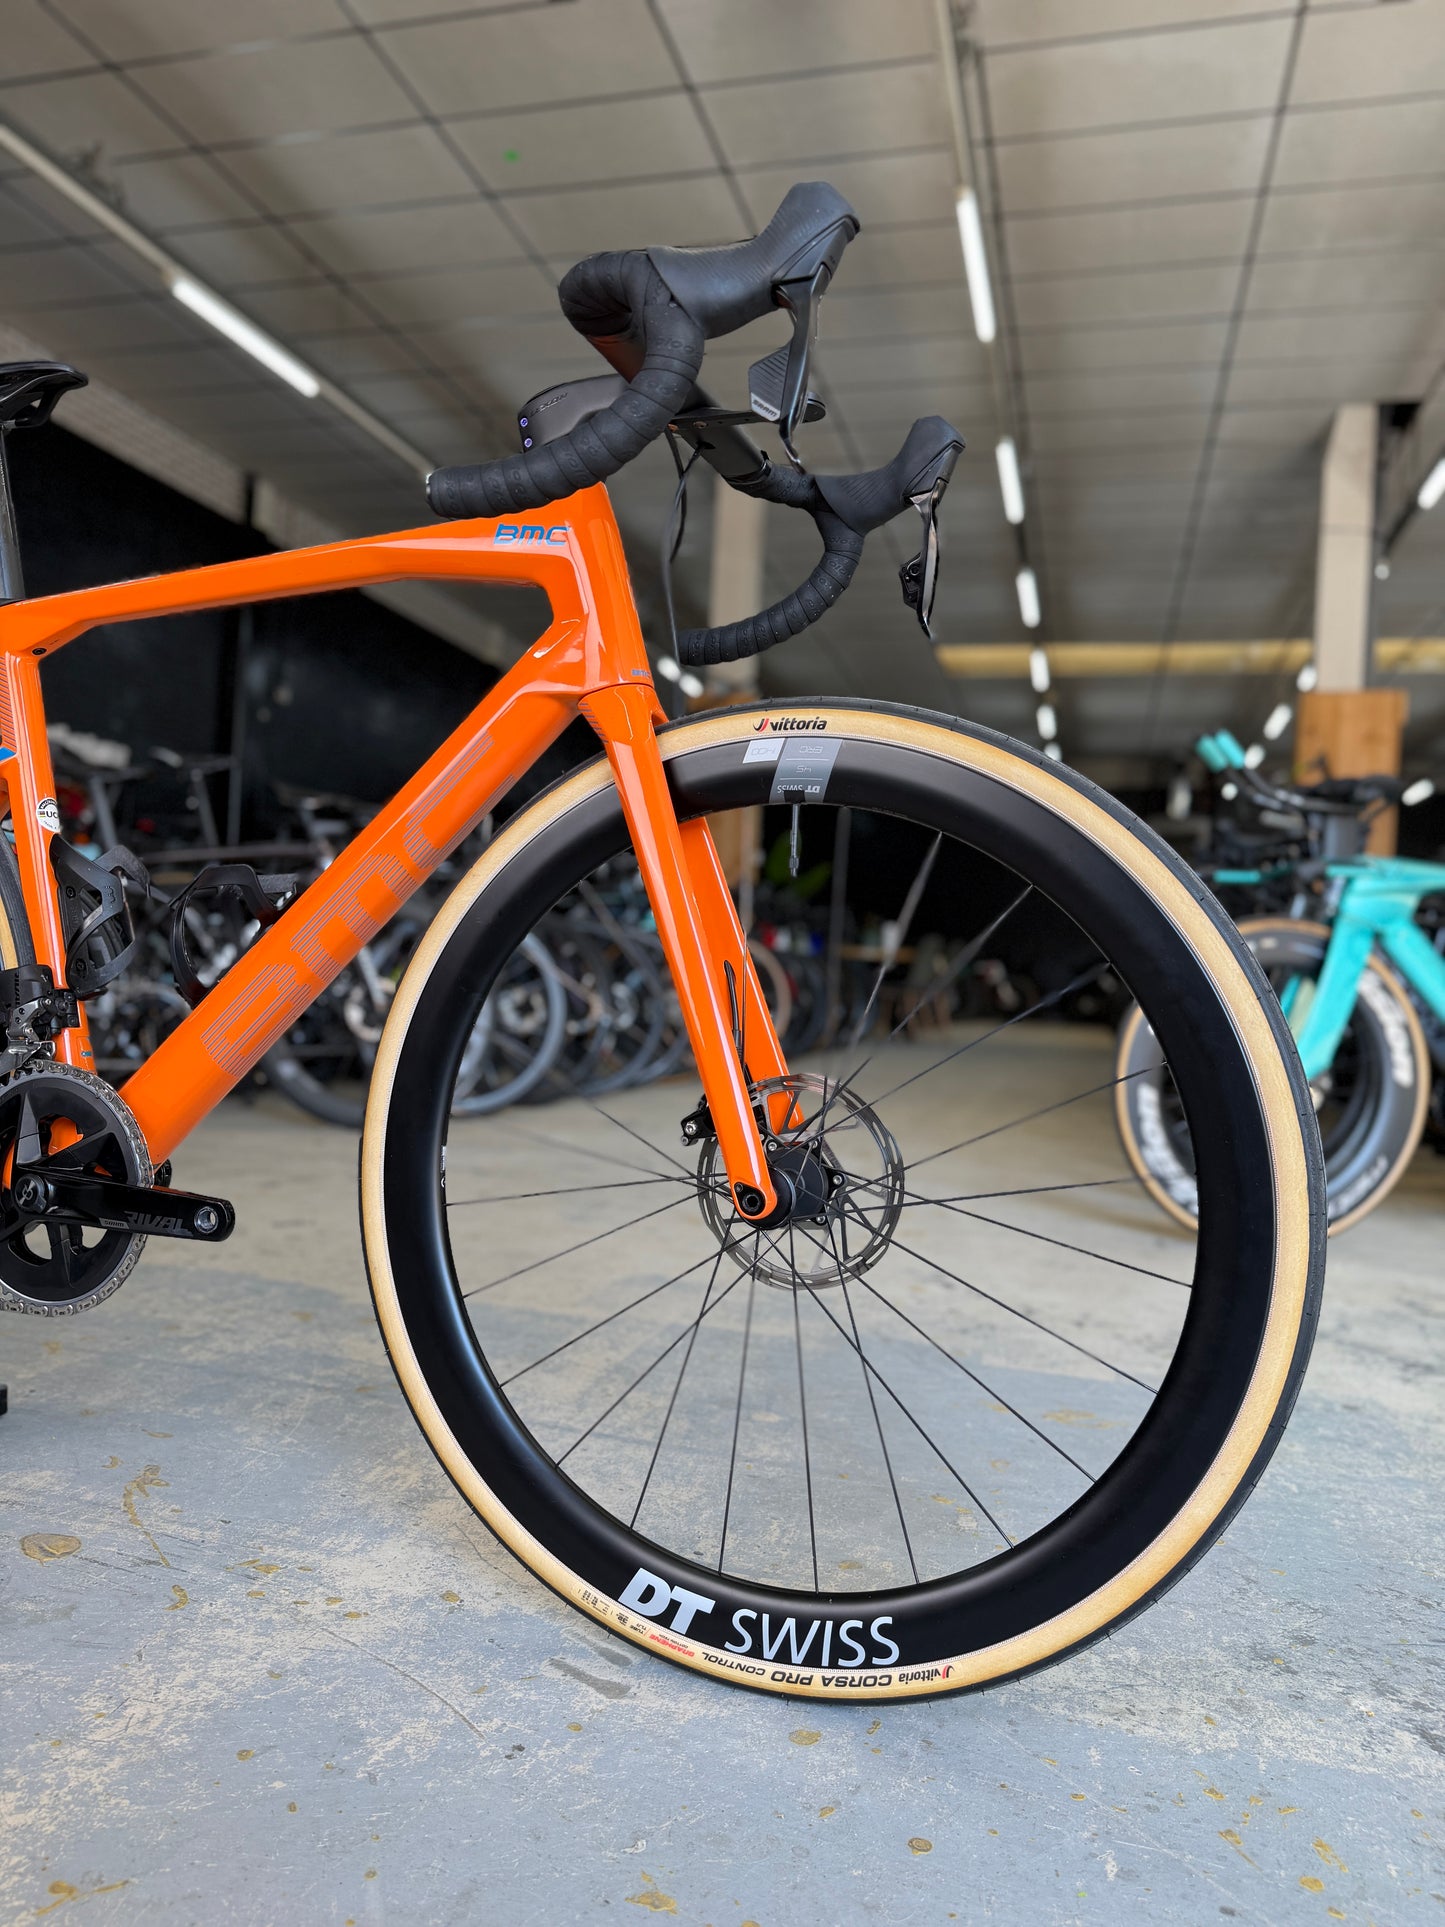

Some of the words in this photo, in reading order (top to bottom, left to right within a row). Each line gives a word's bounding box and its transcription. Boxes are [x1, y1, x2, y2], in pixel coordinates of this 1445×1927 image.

[752, 399, 778, 417] SRAM
[493, 523, 570, 546] BMC
[770, 716, 828, 731] vittoria
[805, 785, 821, 793] DT
[124, 1210, 187, 1232] RIVAL
[618, 1567, 716, 1635] DT
[724, 1608, 900, 1668] SWISS
[702, 1651, 766, 1676] CONTROL
[770, 1670, 814, 1686] PRO
[821, 1674, 892, 1688] CORSA
[899, 1666, 942, 1685] vittoria
